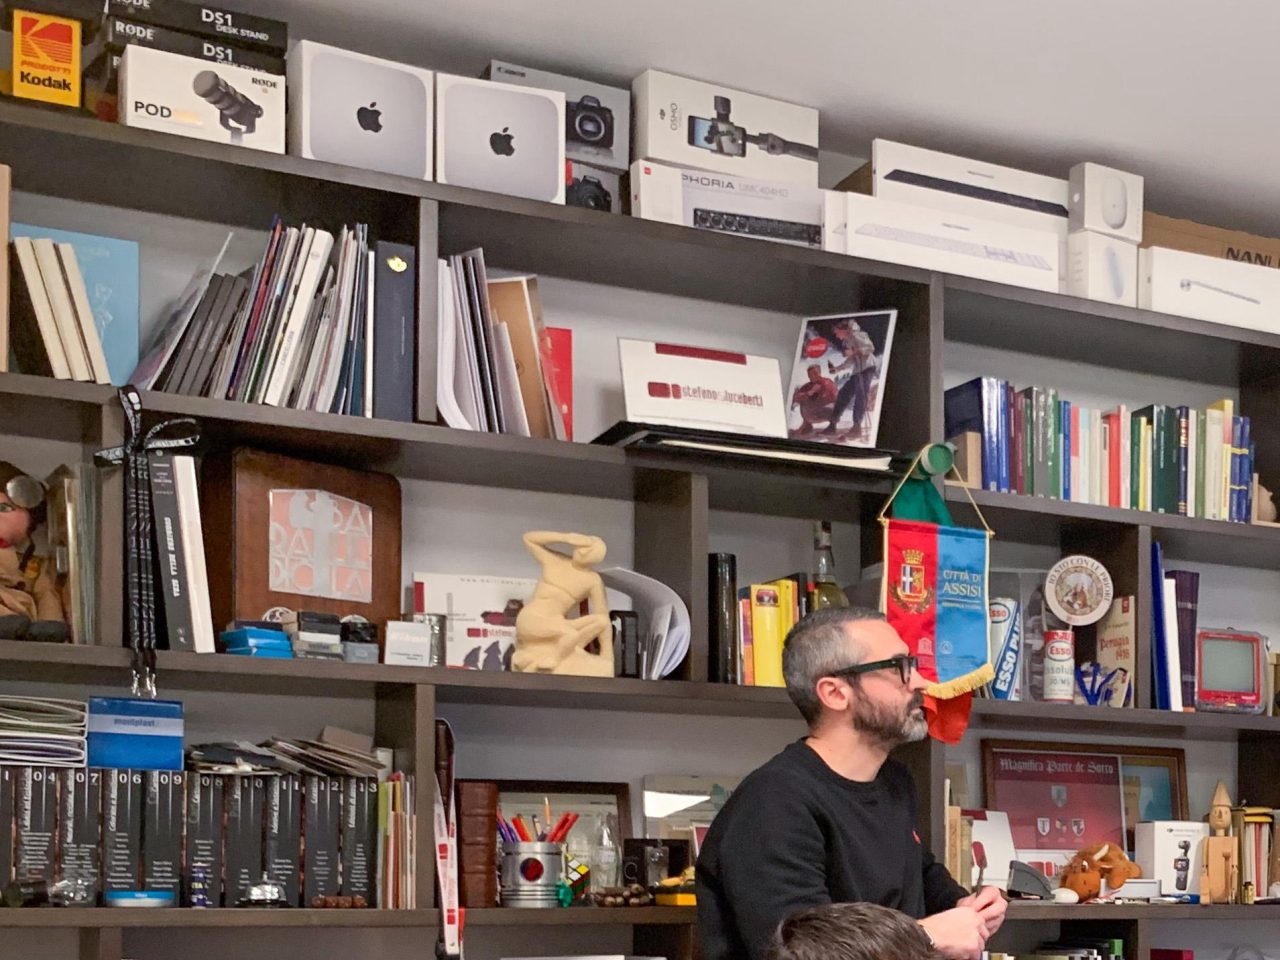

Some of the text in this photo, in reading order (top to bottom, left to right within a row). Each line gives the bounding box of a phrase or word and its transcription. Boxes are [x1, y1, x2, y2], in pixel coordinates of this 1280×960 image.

[201, 9, 233, 26] DS1
[216, 24, 269, 41] DESK STAND
[203, 43, 233, 61] DS1
[497, 66, 526, 78] Canon
[20, 71, 72, 92] Kodak
[670, 103, 679, 131] OSMO
[943, 582, 981, 598] ASSISI
[995, 651, 1016, 691] ESSO
[5, 771, 9, 781] 1
[76, 772, 99, 784] 07
[119, 773, 142, 785] 06
[160, 774, 182, 786] 09
[281, 779, 299, 791] 11
[359, 782, 378, 793] 13
